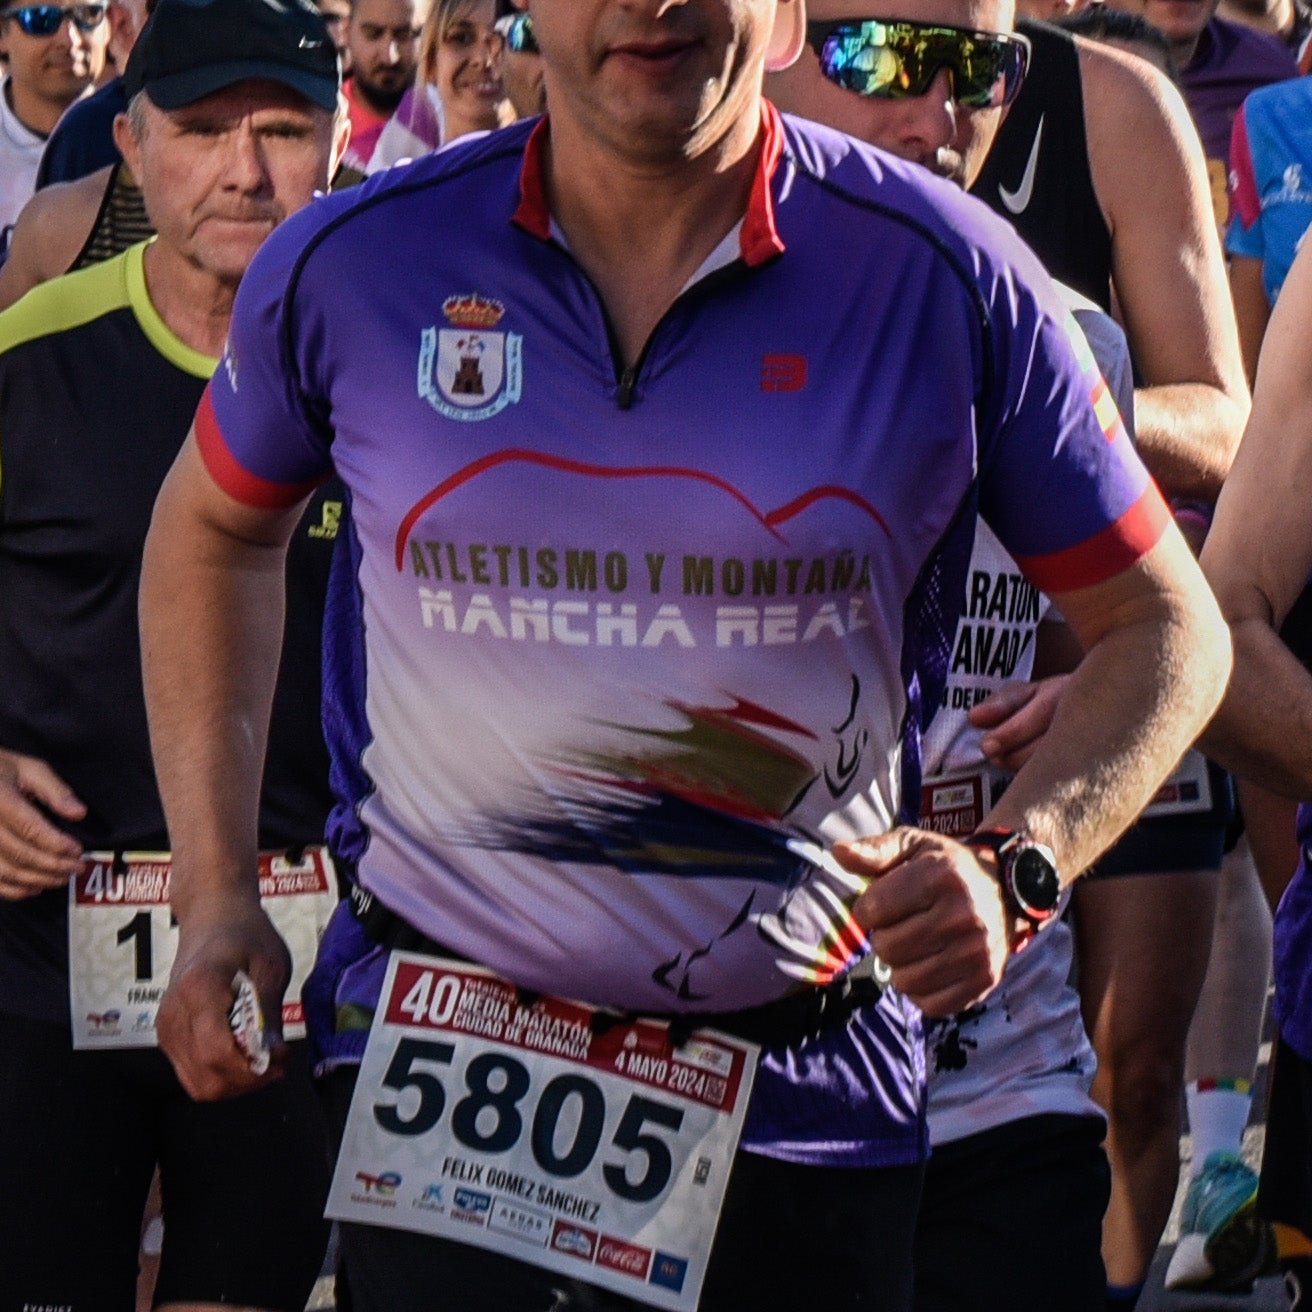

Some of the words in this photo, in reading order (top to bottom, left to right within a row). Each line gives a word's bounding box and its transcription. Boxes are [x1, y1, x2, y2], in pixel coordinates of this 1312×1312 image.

[410, 539, 628, 592] ATLETISMO
[647, 553, 666, 593] Y
[683, 549, 872, 597] MONTAÑA
[418, 587, 697, 648] MANCHA
[715, 598, 871, 648] REAL
[933, 812, 960, 834] 2024
[400, 970, 462, 1028] 40
[458, 991, 510, 1025] MEDIA
[513, 1004, 594, 1044] MARATÓN
[452, 1013, 502, 1039] CIUDAD
[504, 1023, 523, 1044] DE
[525, 1028, 591, 1061] GRANADA
[614, 1050, 626, 1069] 4
[626, 1051, 669, 1085] MAYO
[668, 1064, 707, 1098] 2024
[372, 1035, 687, 1204] 5805
[440, 1156, 484, 1187] FELIX
[486, 1168, 537, 1203] GOMEZ
[535, 1182, 602, 1222] SANCHEZ
